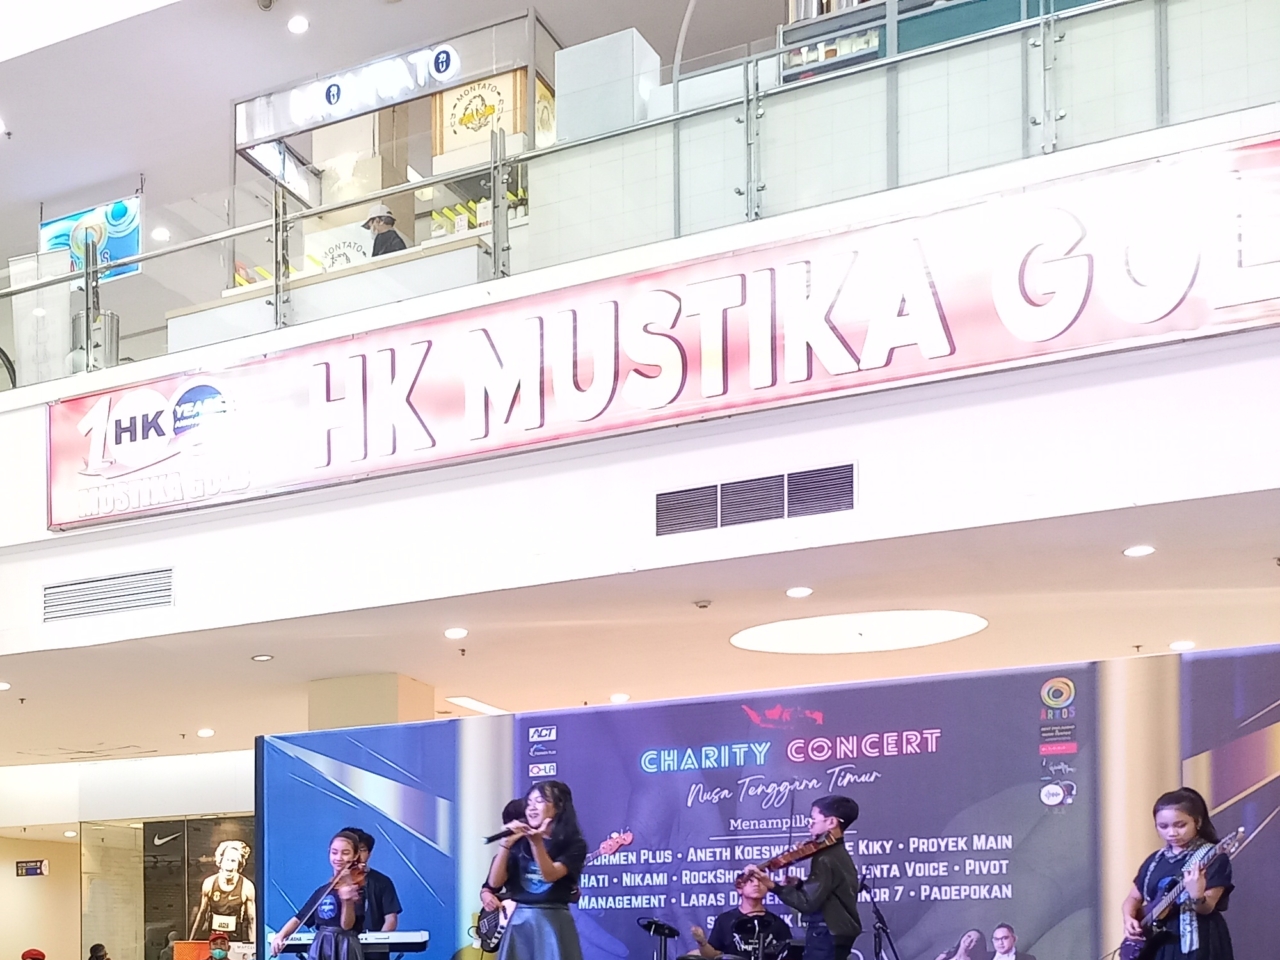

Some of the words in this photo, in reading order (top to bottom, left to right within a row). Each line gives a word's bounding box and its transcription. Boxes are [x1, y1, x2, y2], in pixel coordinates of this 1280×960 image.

[455, 82, 499, 103] MONTATO
[310, 338, 440, 470] HK
[468, 248, 955, 440] MUSTIKA
[114, 409, 166, 445] HK
[1040, 705, 1076, 720] ARTOS
[531, 728, 555, 739] ACT
[640, 741, 771, 774] CHARITY
[786, 728, 943, 763] CONCERT
[686, 783, 733, 808] Nusa
[737, 774, 823, 809] Tenggara
[826, 763, 882, 793] Timur
[640, 849, 673, 864] PLUS
[686, 845, 732, 863] ANETH
[858, 839, 894, 856] KIKY
[908, 836, 969, 854] PROYEK
[972, 834, 1013, 851] MAIN
[580, 873, 609, 888] HATI
[622, 871, 669, 888] NIKAMI
[904, 861, 949, 878] VOICE
[965, 859, 1010, 876] PIVOT
[578, 894, 666, 910] MANAGEMENT
[680, 892, 726, 908] LARAS
[894, 885, 905, 902] 7
[920, 884, 1013, 901] PADEPOKAN
